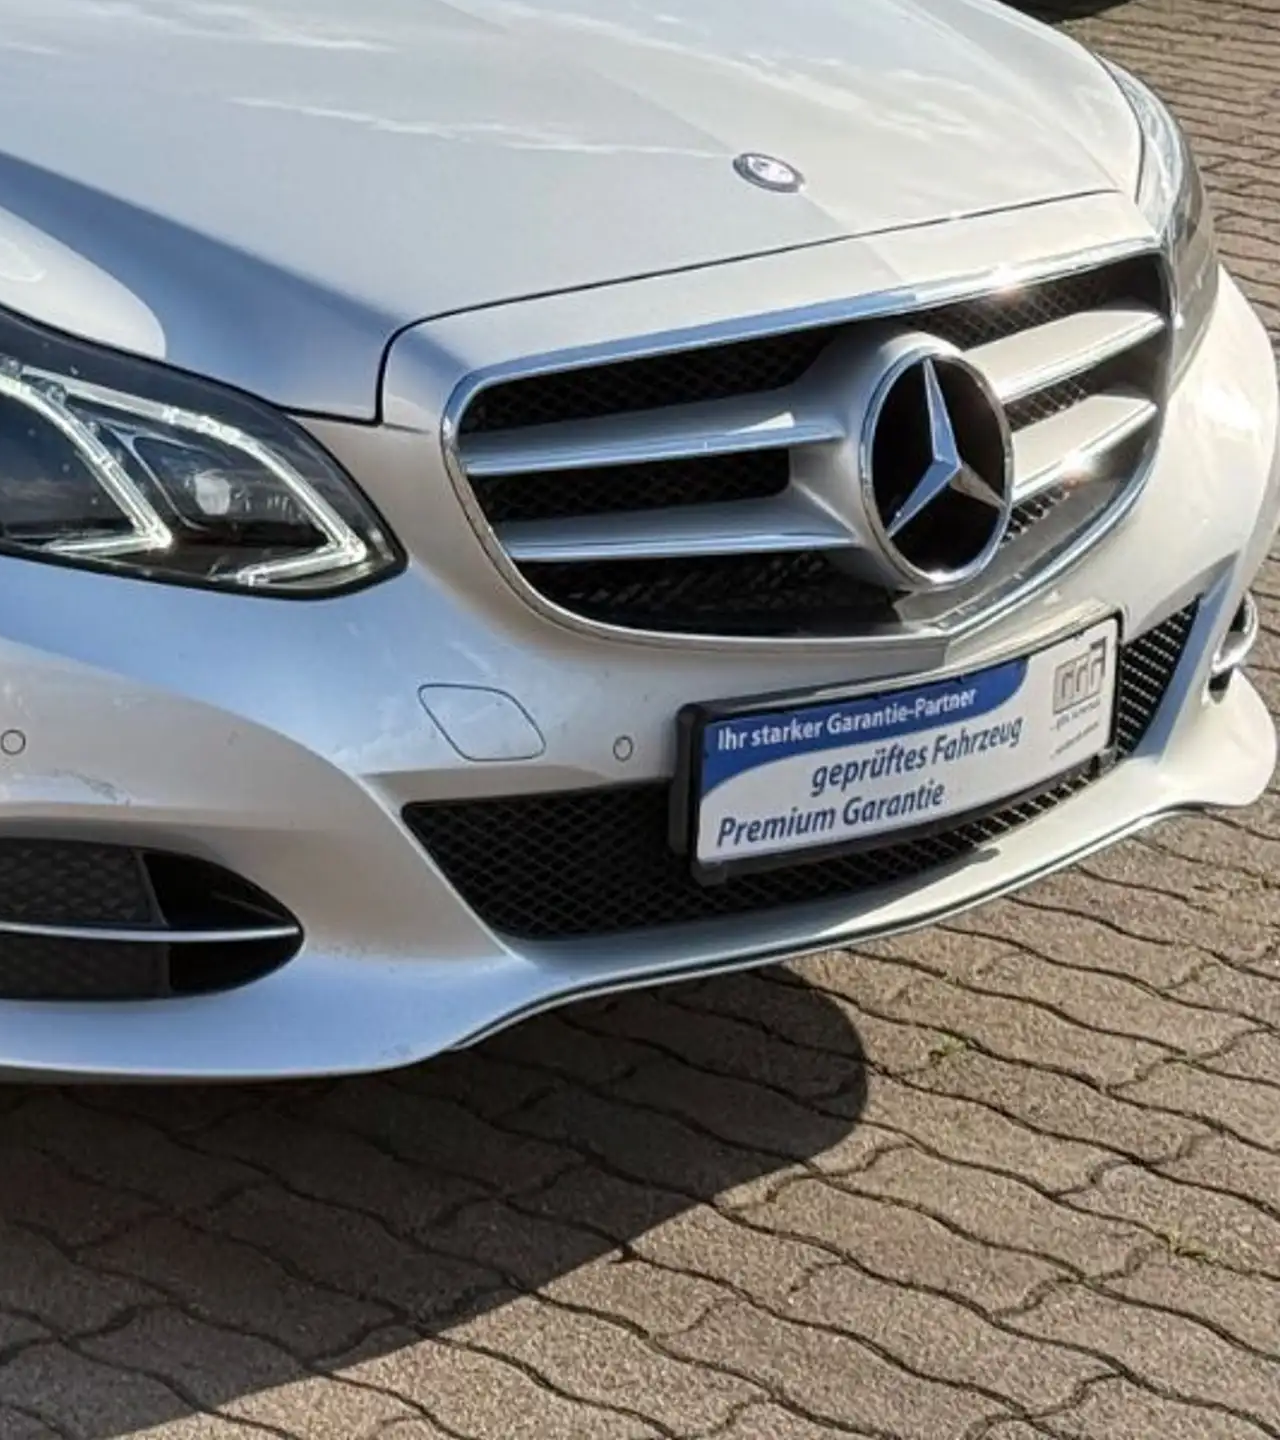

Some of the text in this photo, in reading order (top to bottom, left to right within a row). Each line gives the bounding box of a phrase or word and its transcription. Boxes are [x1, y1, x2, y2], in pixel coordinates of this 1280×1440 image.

[717, 686, 979, 752] Ihr starker Garantie-Partner
[810, 739, 928, 798] geprüftes
[931, 714, 1025, 767] Fahrzeug
[716, 779, 946, 849] Premium Garantie
